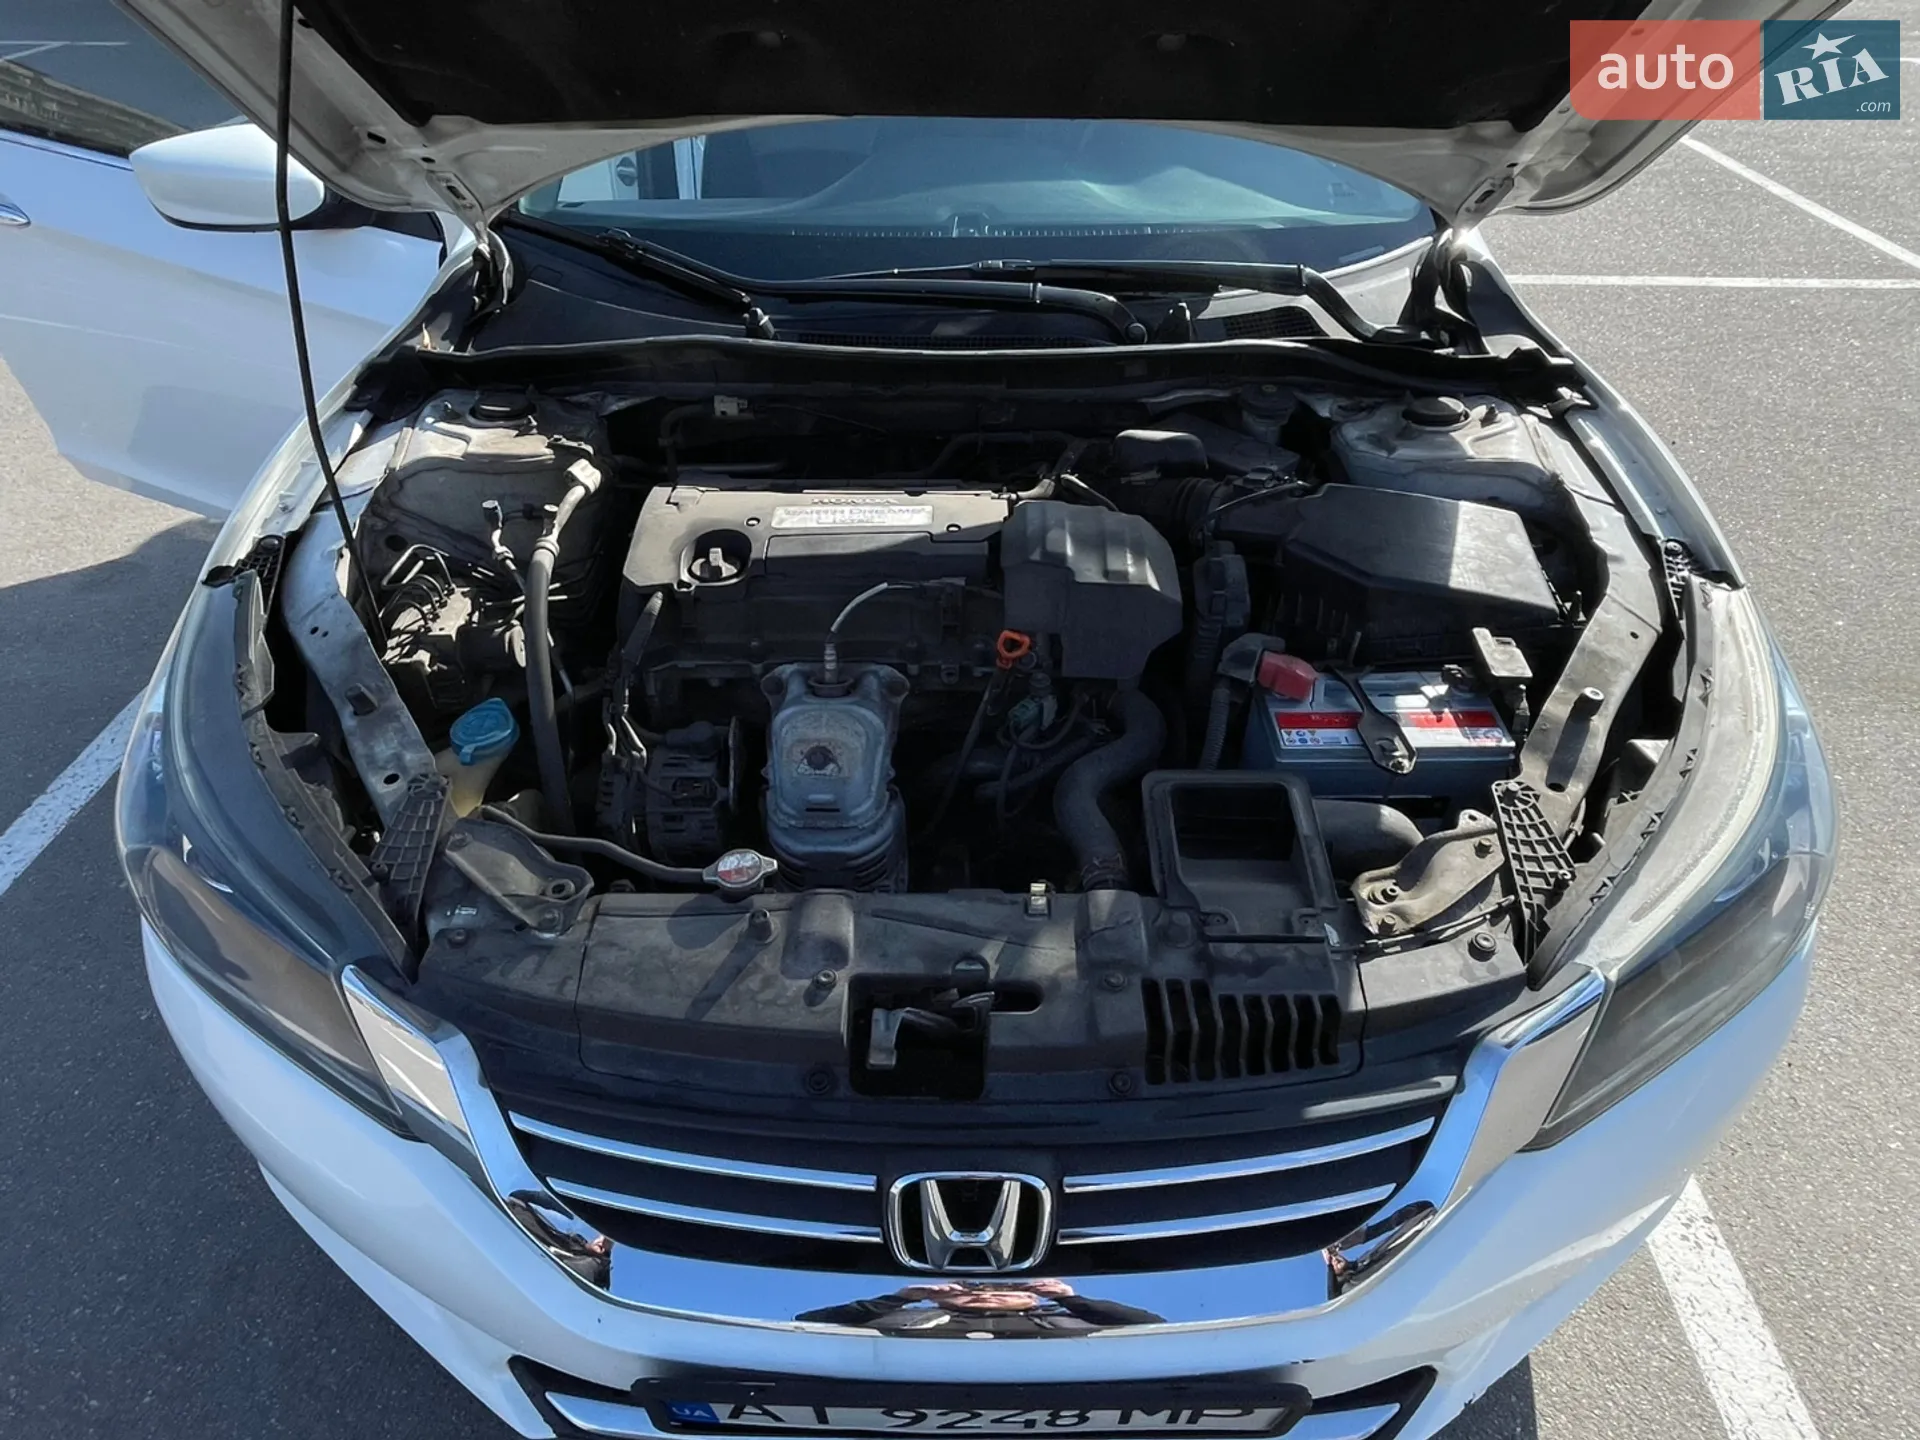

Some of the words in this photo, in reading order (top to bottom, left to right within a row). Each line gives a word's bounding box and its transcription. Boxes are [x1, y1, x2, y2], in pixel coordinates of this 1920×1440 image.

[672, 1406, 711, 1418] UA
[881, 1407, 1091, 1429] 9248
[1117, 1408, 1255, 1425] MP
